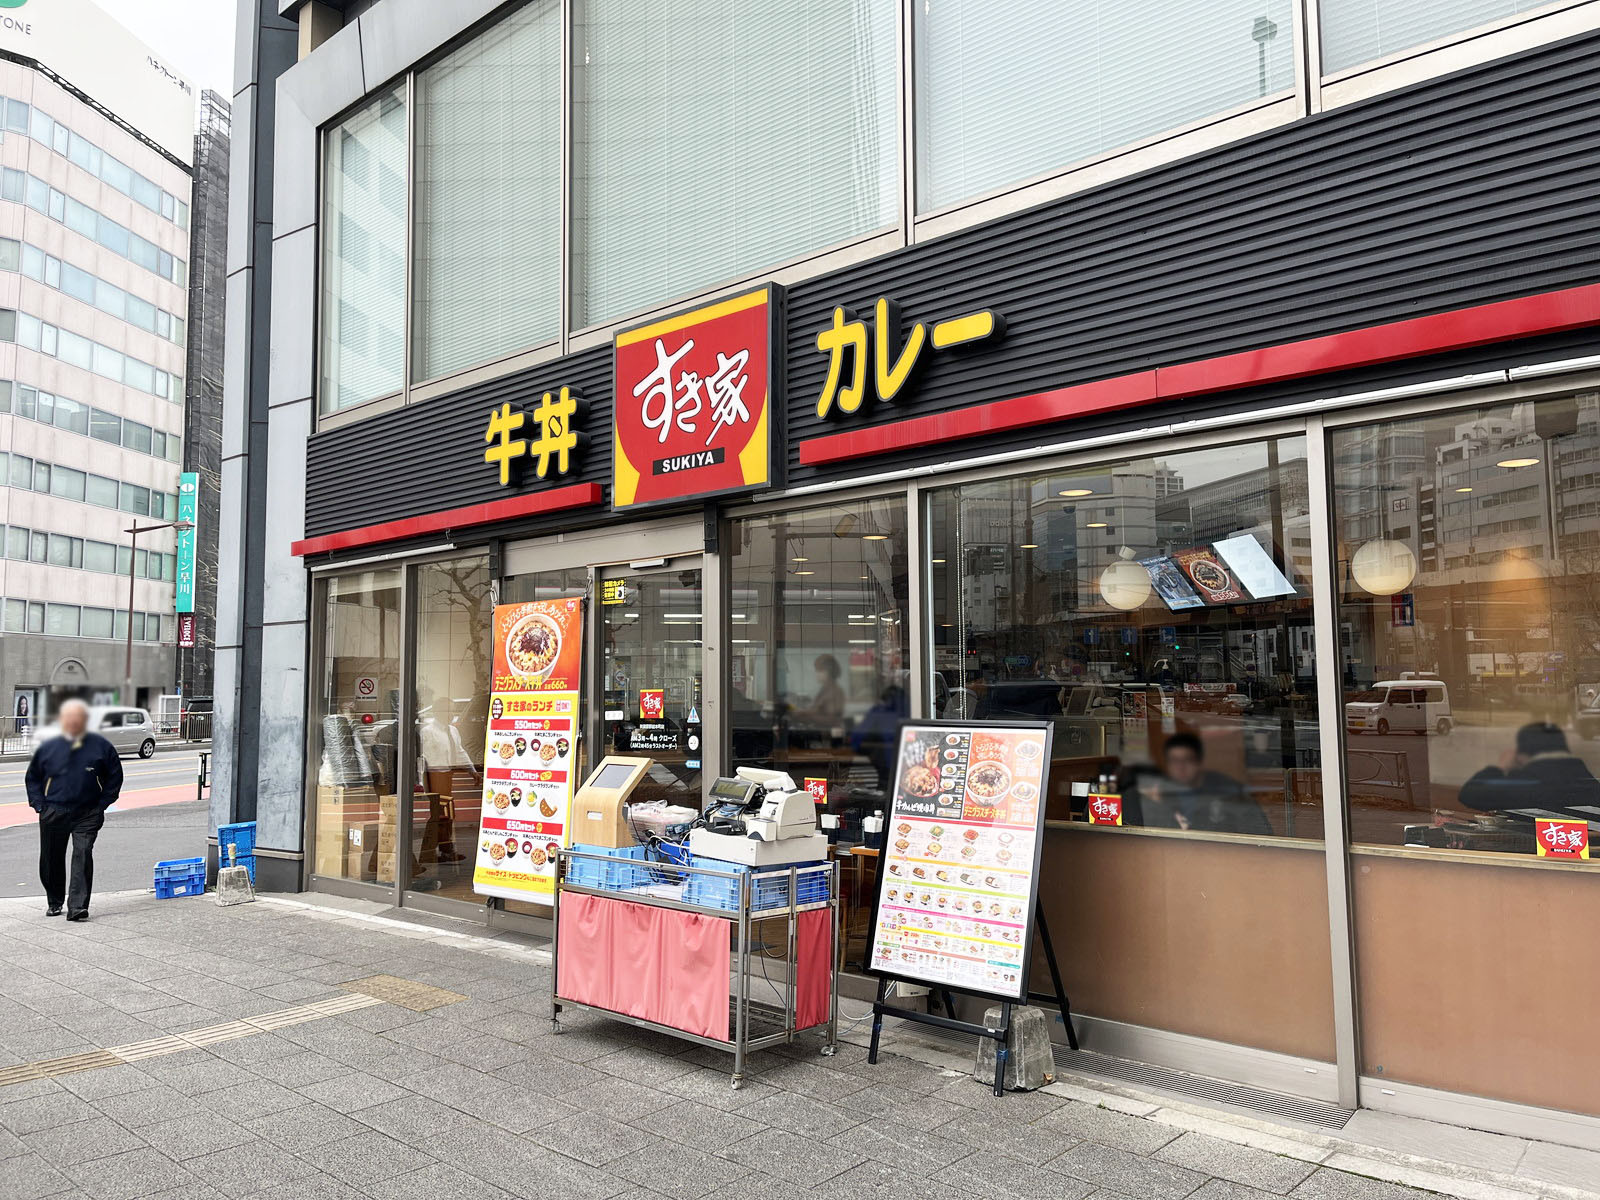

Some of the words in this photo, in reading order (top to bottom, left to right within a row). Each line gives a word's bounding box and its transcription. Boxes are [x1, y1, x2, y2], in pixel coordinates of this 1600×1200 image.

[815, 296, 996, 421] カレー
[633, 338, 751, 446] すき家
[484, 385, 579, 487] 牛丼
[661, 451, 715, 473] SUKIYA
[506, 700, 553, 712] すき家のランチ
[1542, 822, 1583, 849] すき家
